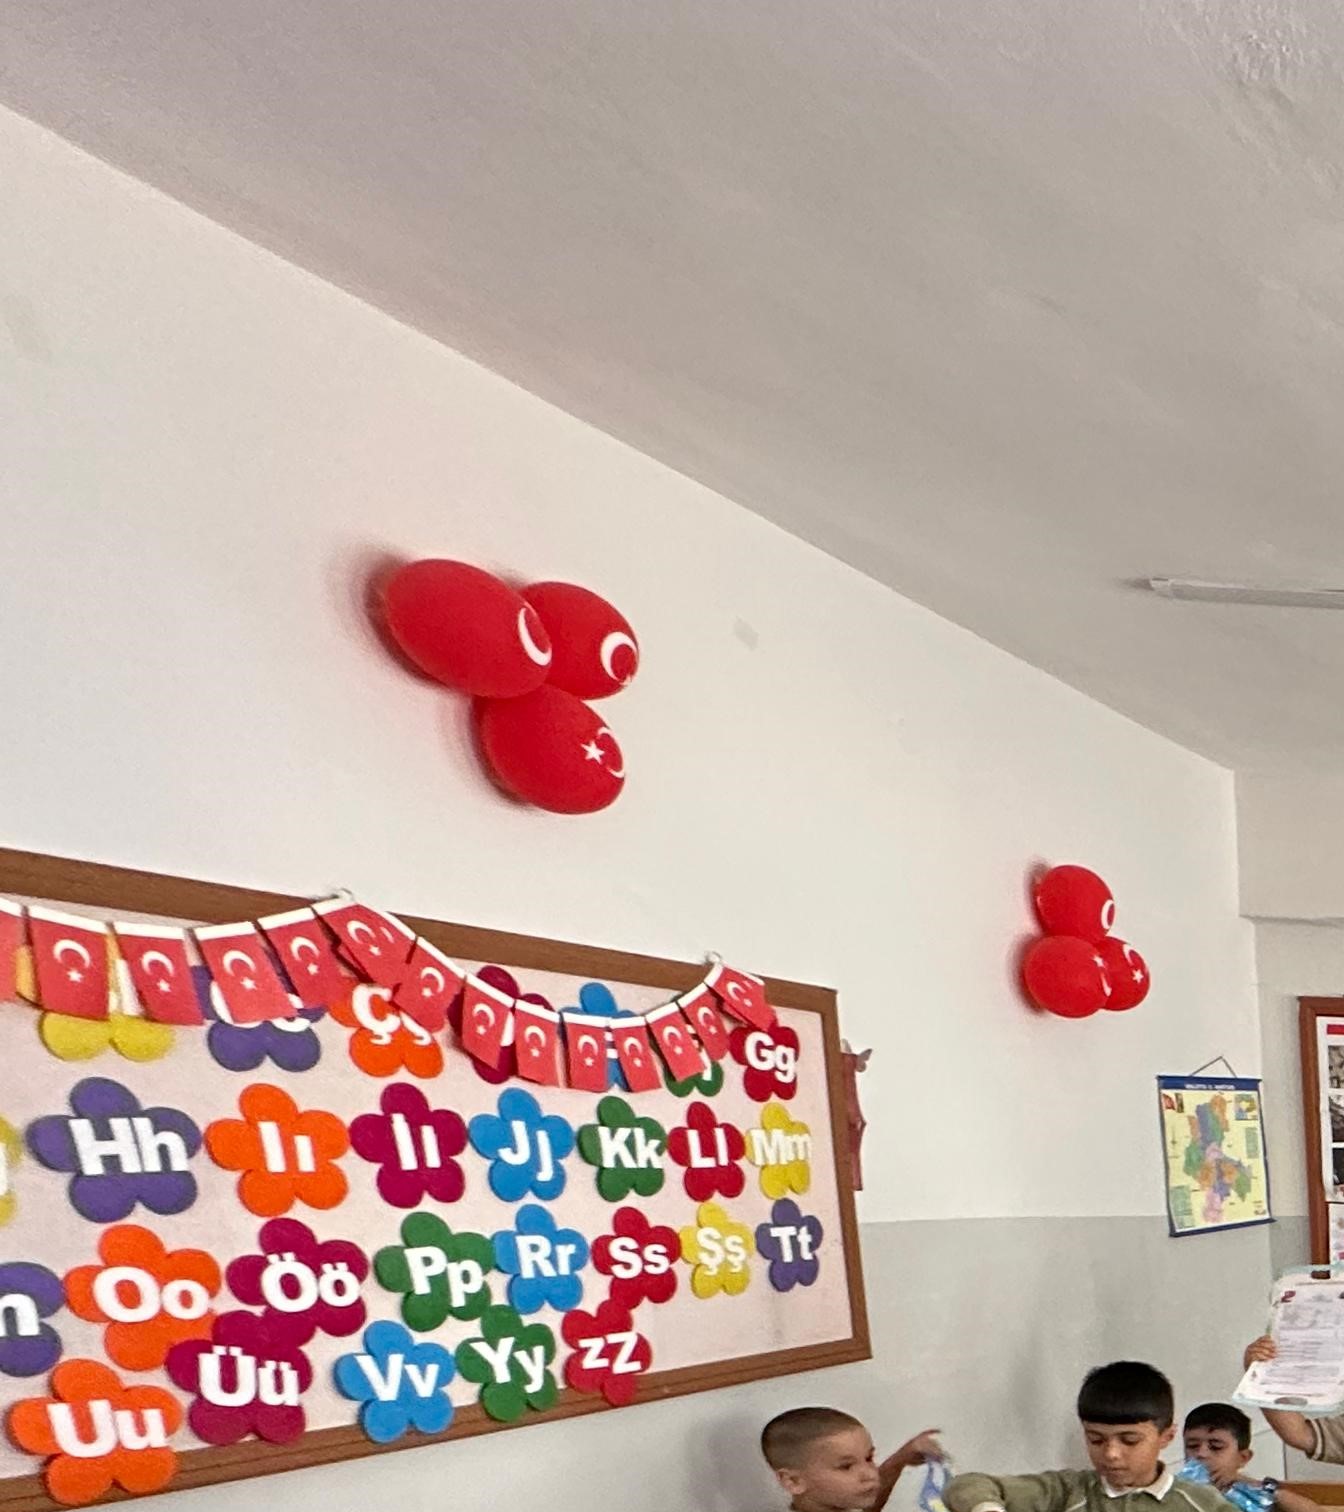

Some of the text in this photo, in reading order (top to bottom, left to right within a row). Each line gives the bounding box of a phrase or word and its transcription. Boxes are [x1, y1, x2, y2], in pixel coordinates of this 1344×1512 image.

[744, 1032, 797, 1083] Gg
[68, 1117, 189, 1176] Hh
[499, 1120, 554, 1182] Jj
[597, 1126, 664, 1169] Kk
[751, 1129, 812, 1167] Mm
[515, 1235, 575, 1279] Rr
[609, 1237, 670, 1279] Ss
[696, 1226, 746, 1277] Şş
[770, 1226, 813, 1264] Tt
[93, 1266, 210, 1323] Oo
[261, 1252, 361, 1313] Öö
[404, 1246, 484, 1308] Pp
[199, 1345, 300, 1407] Üü
[356, 1353, 439, 1401] Vv
[472, 1337, 545, 1393] Yy
[579, 1331, 641, 1375] zZ
[46, 1399, 169, 1458] Uu
